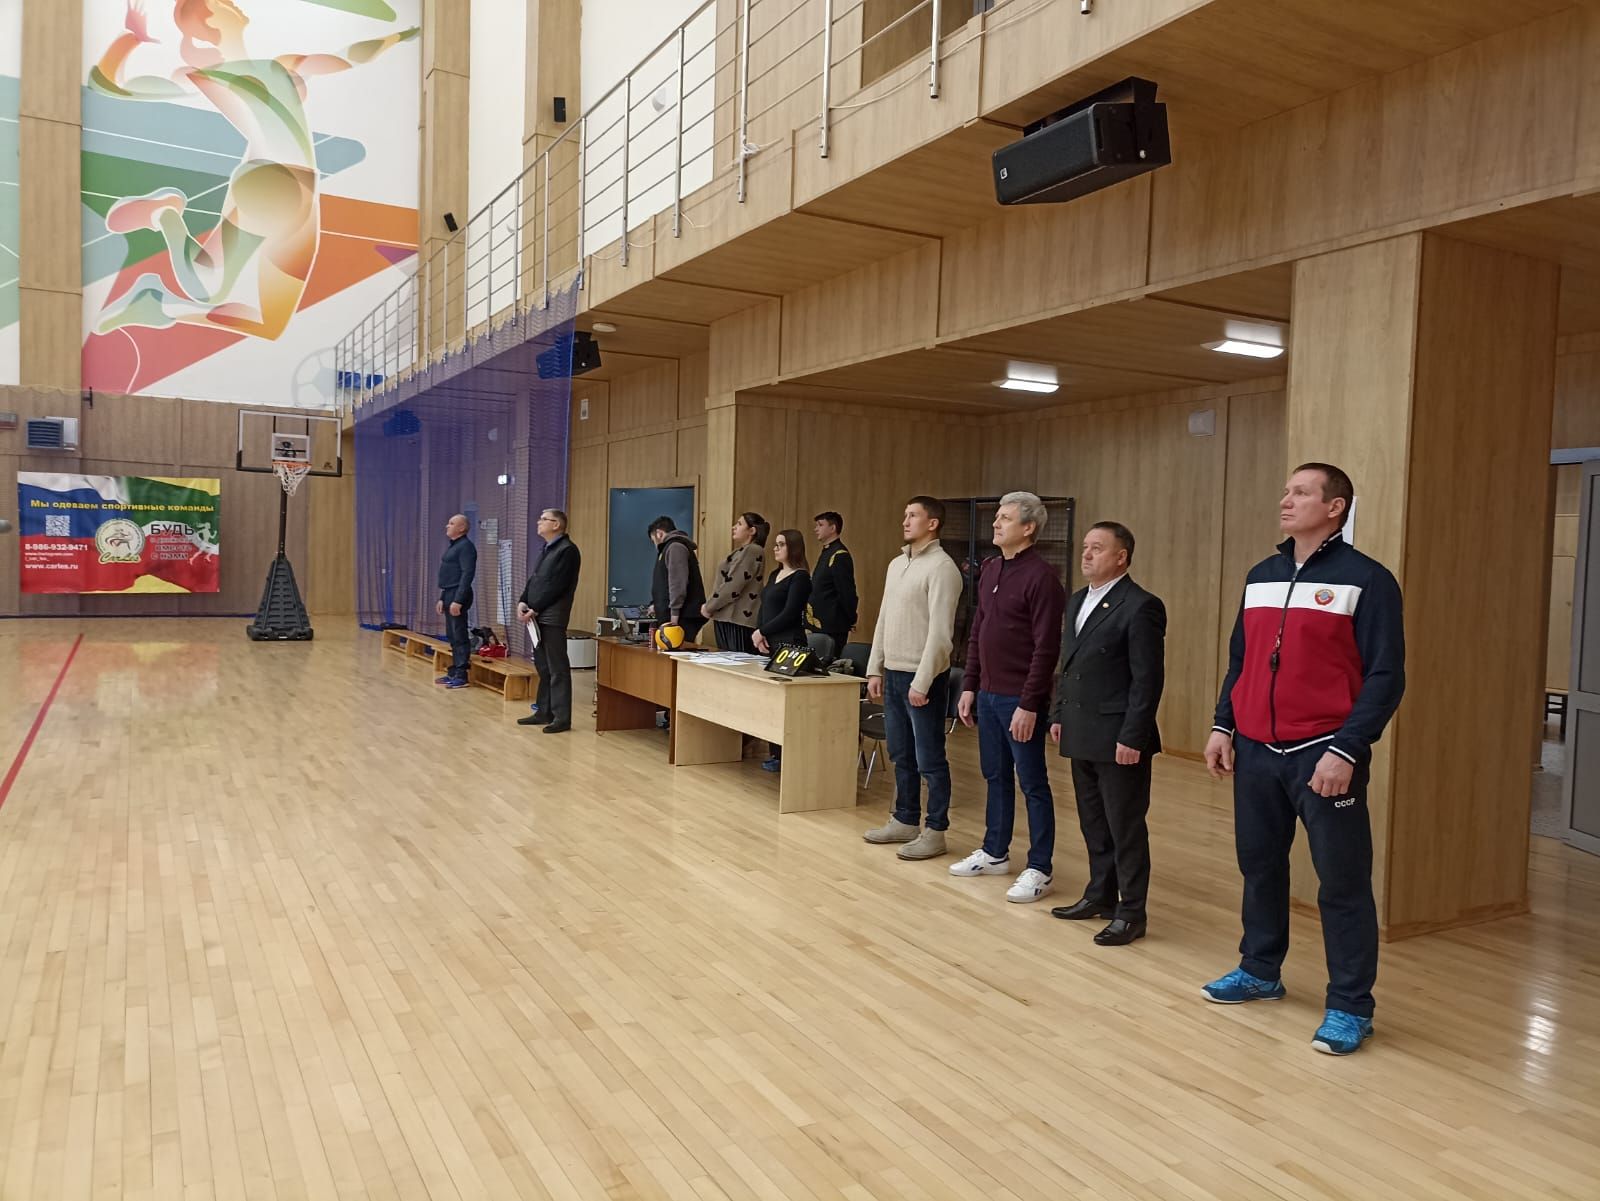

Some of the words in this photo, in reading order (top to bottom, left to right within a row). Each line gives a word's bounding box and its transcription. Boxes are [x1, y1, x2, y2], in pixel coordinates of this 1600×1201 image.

[31, 500, 49, 508] Мы
[52, 501, 98, 510] одеваем
[101, 503, 166, 511] спортивные
[151, 524, 194, 537] БУДЬ
[776, 650, 789, 663] 0
[794, 653, 807, 666] 0
[1334, 797, 1356, 808] СССР
